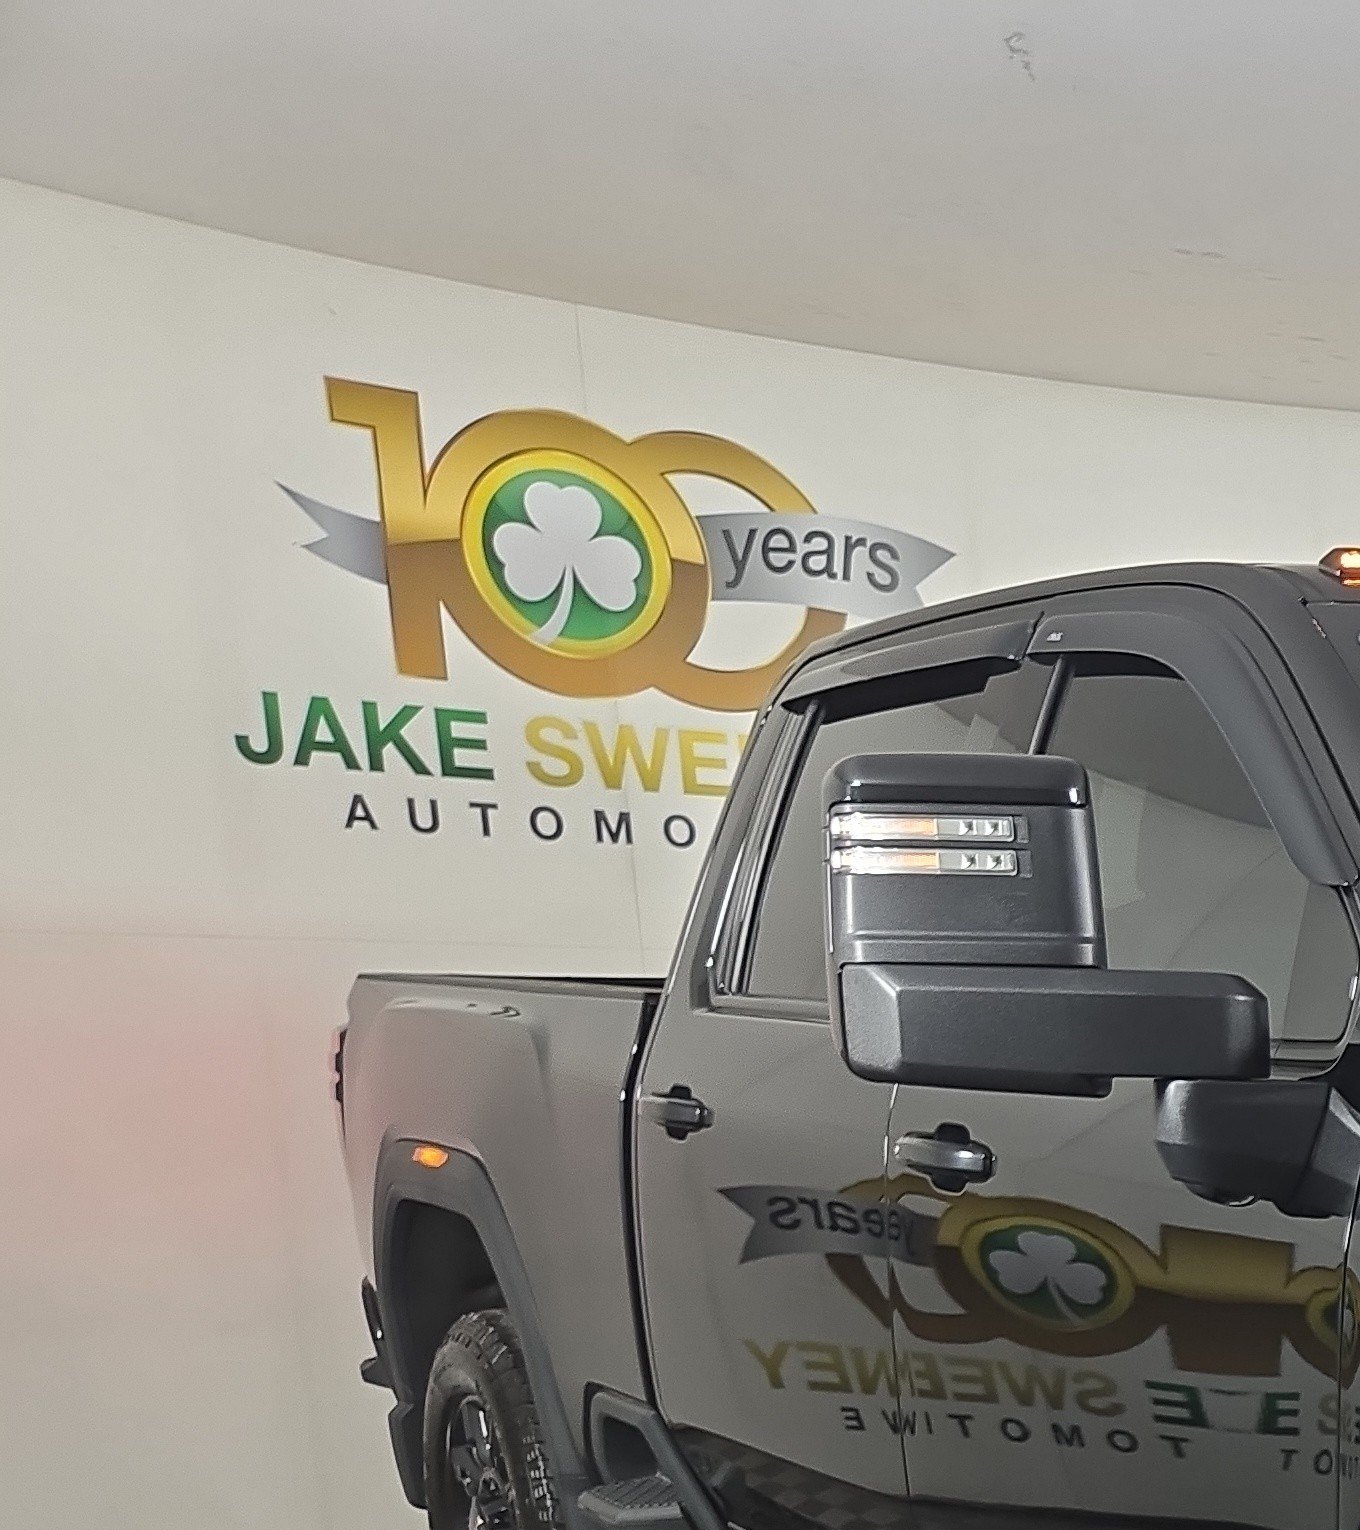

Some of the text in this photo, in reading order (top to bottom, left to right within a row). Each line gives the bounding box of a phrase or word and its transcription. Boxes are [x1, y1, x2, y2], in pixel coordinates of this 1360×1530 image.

[721, 523, 902, 593] years
[233, 690, 745, 798] JAKE SWE
[343, 793, 698, 850] AUTOMO
